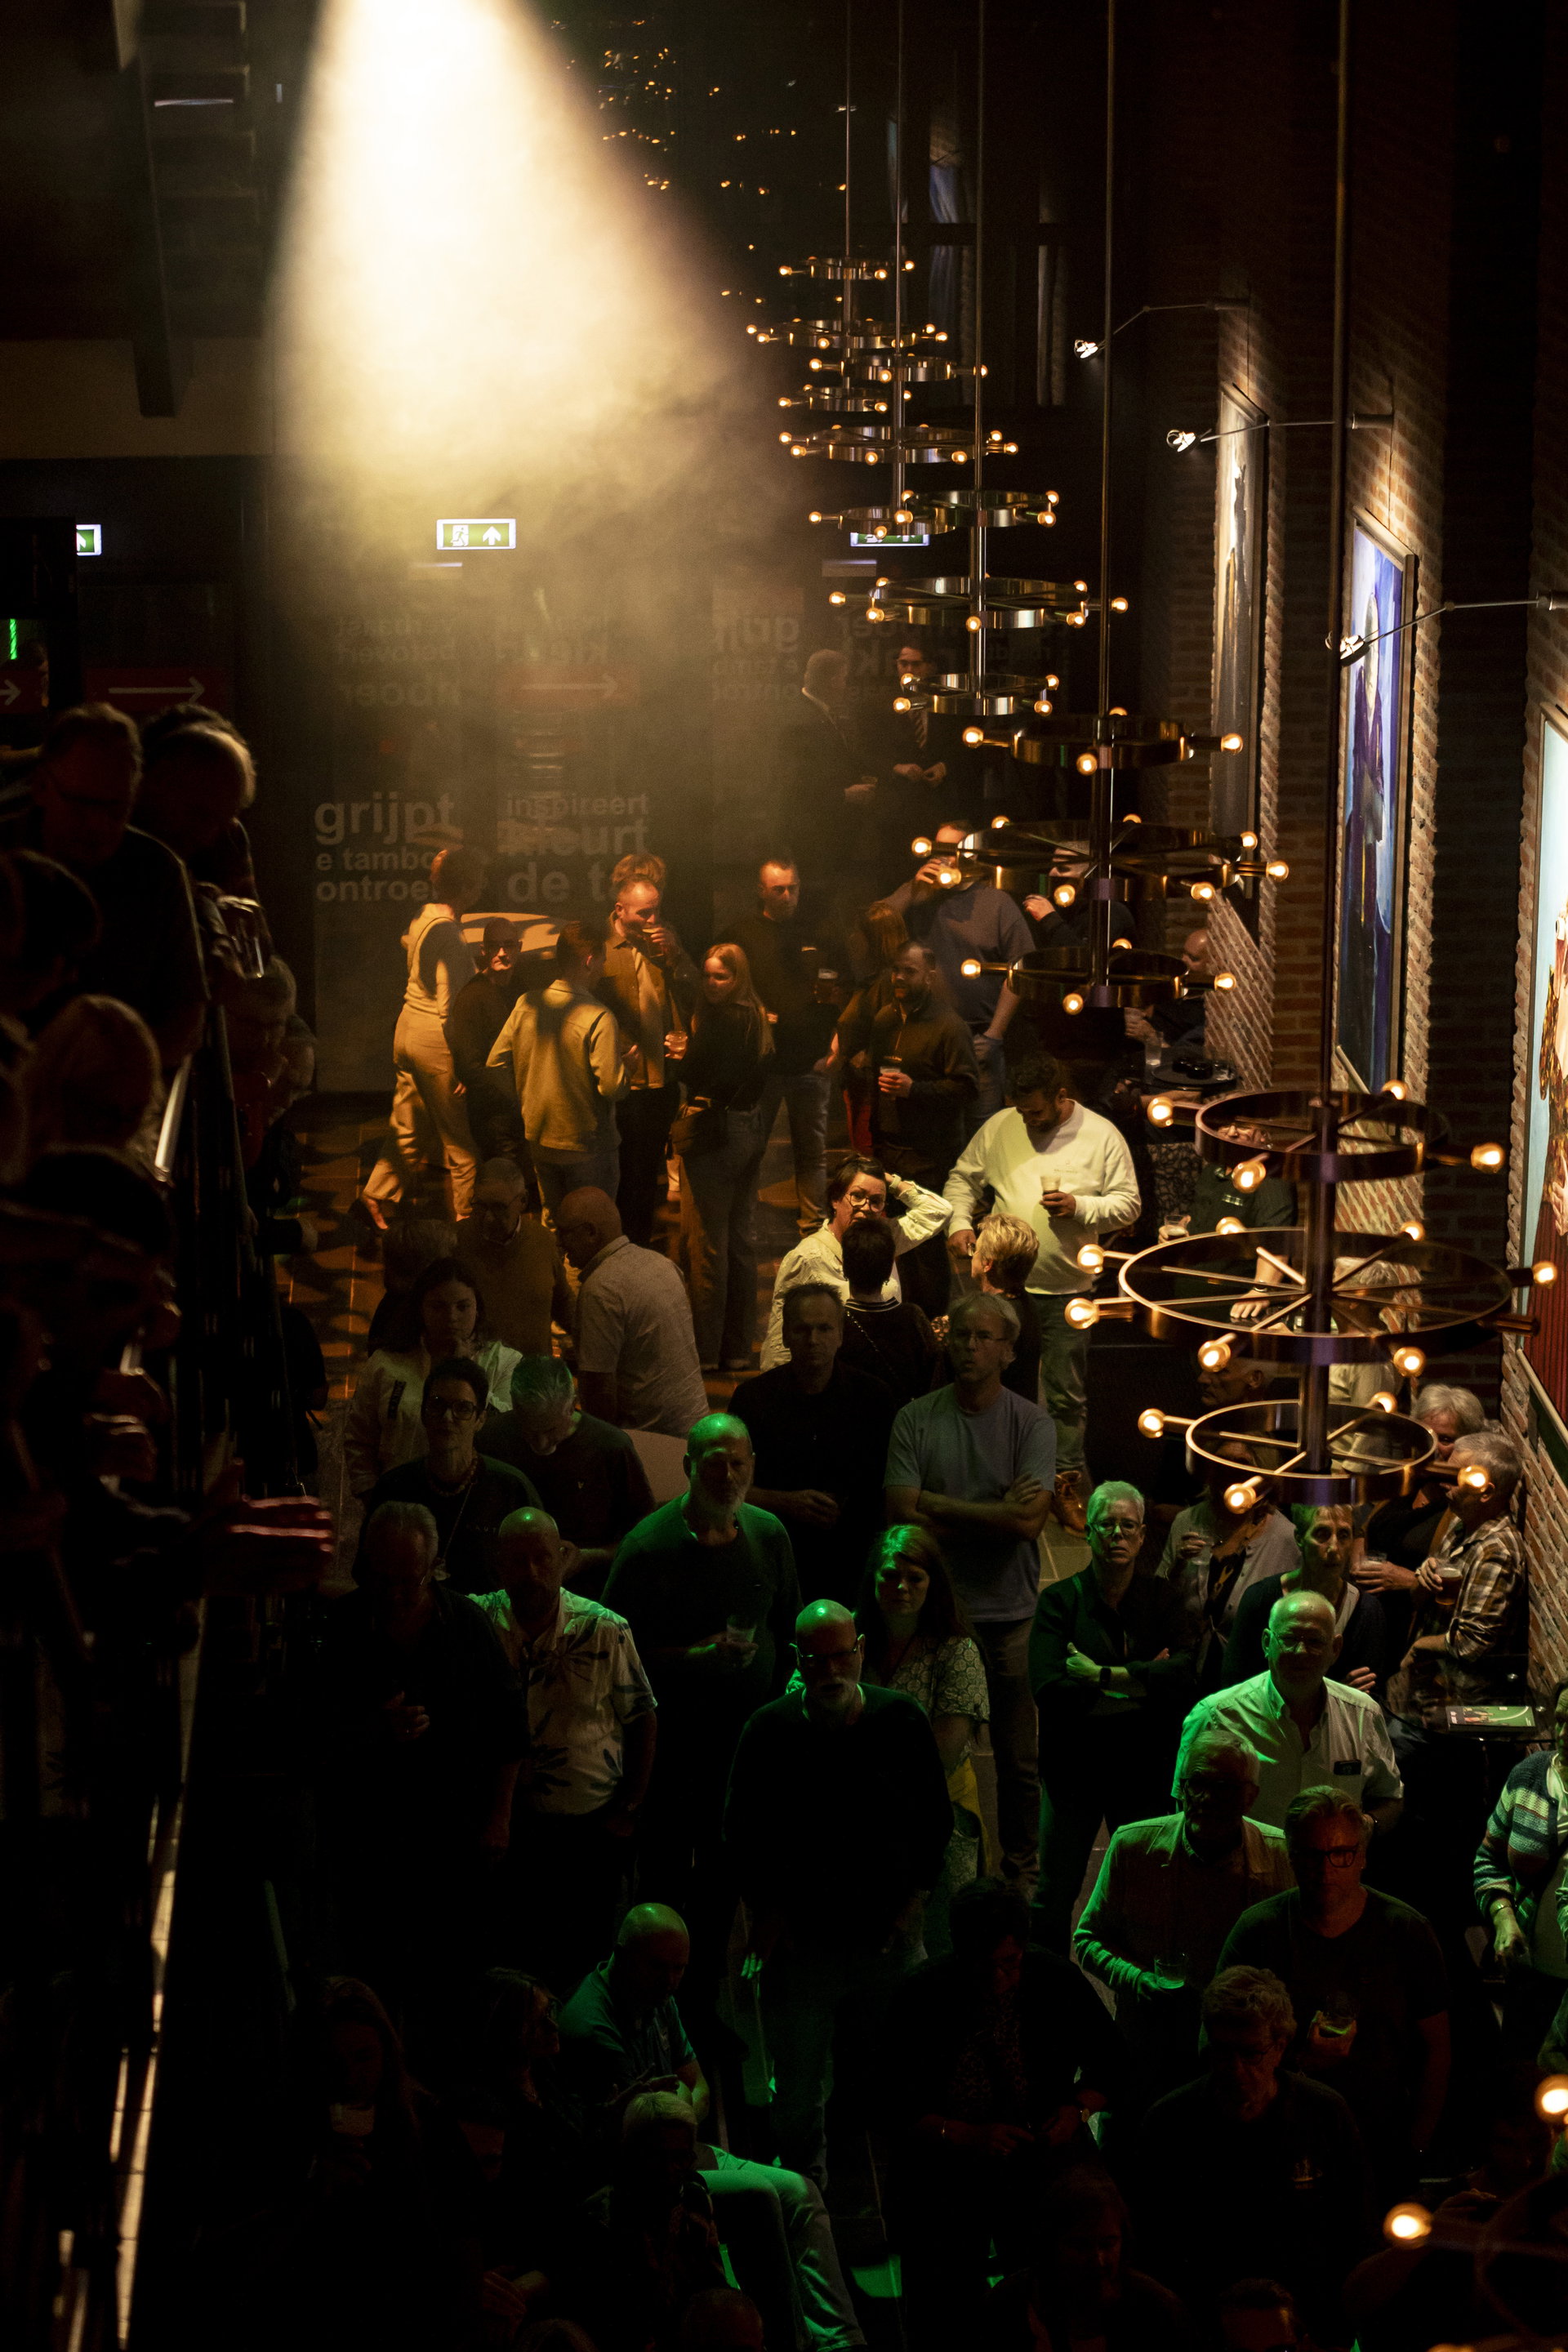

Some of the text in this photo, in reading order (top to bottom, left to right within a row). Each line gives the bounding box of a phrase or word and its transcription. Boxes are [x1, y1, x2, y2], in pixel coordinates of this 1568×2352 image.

[314, 791, 454, 846] grijpt
[506, 791, 649, 819] inspireert
[315, 851, 333, 871] e
[506, 862, 570, 902] de
